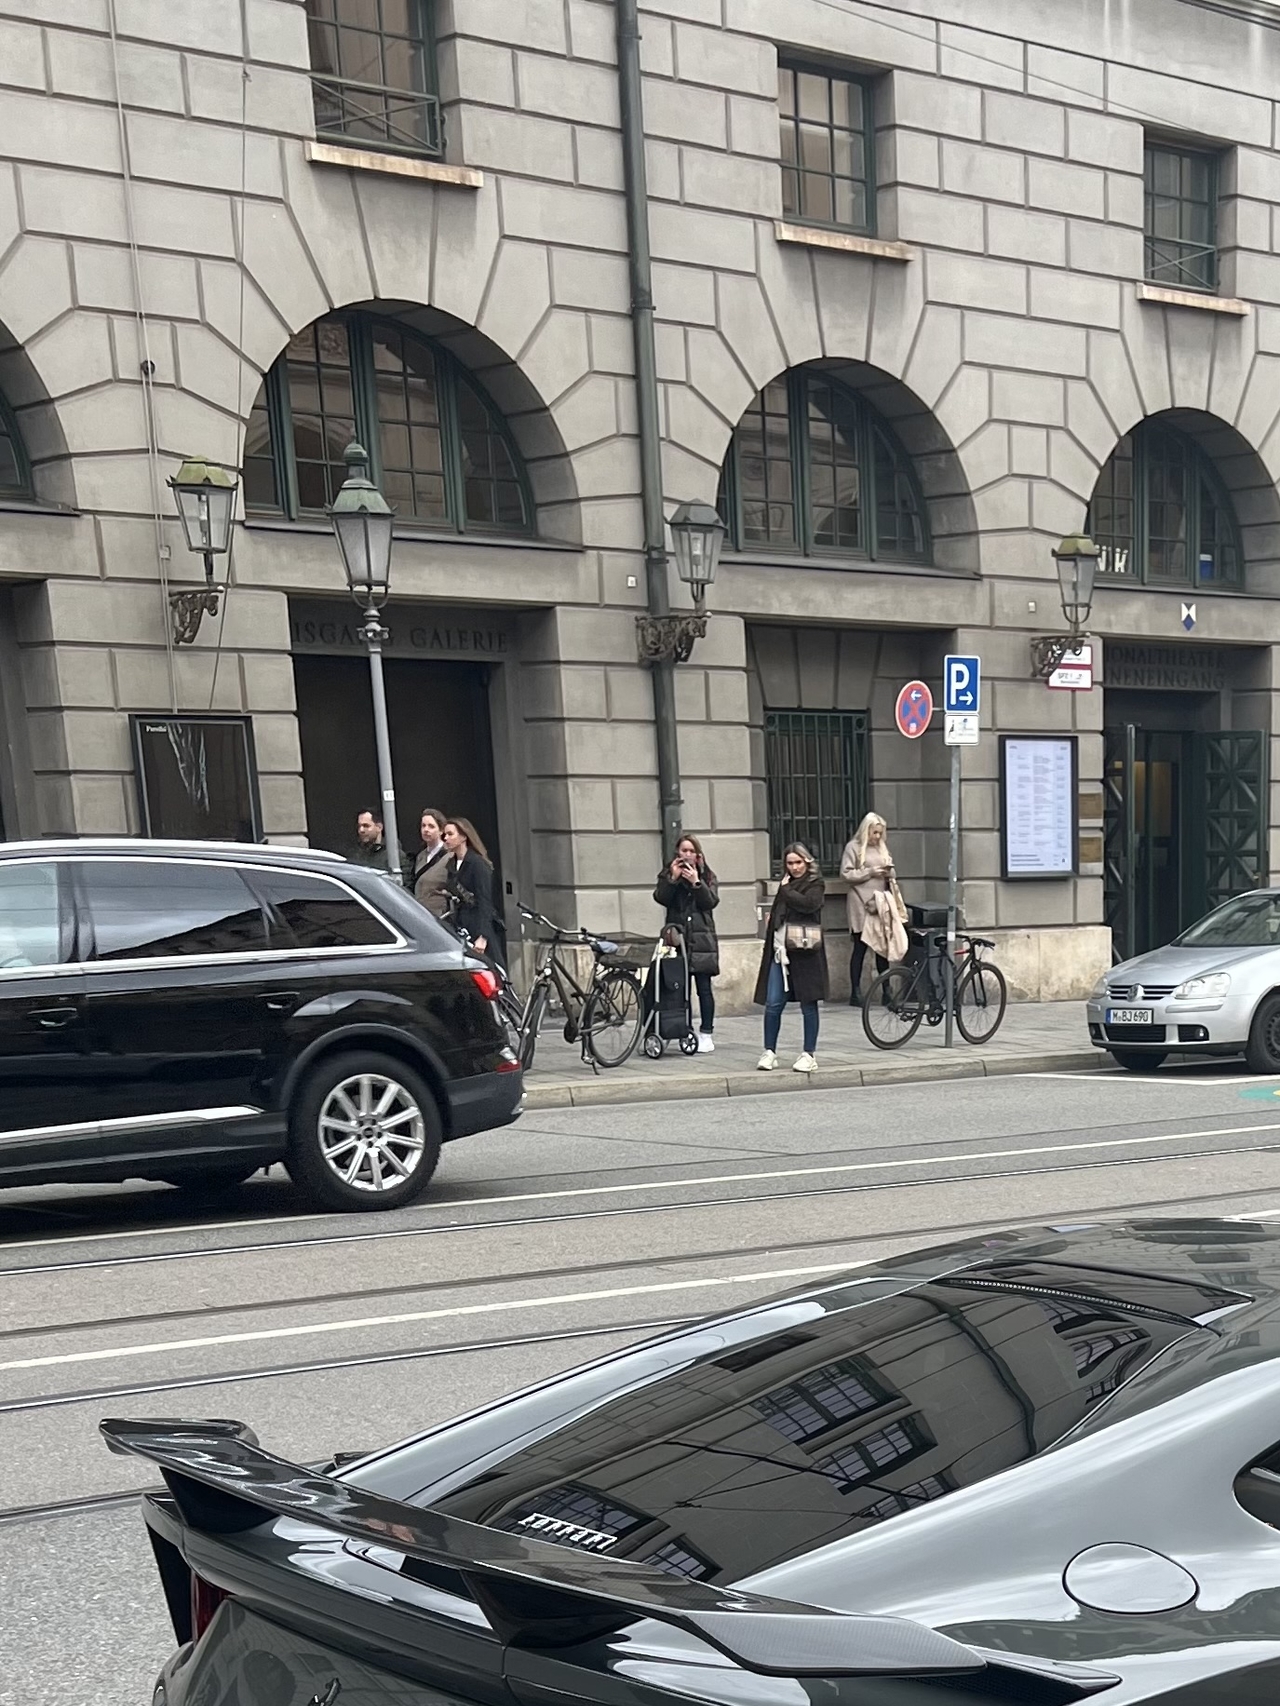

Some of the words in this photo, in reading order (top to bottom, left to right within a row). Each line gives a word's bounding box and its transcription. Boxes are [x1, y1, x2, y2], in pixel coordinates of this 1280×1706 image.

[410, 627, 508, 653] GALERIE
[950, 663, 969, 705] P
[518, 1512, 618, 1550] Ferrari
